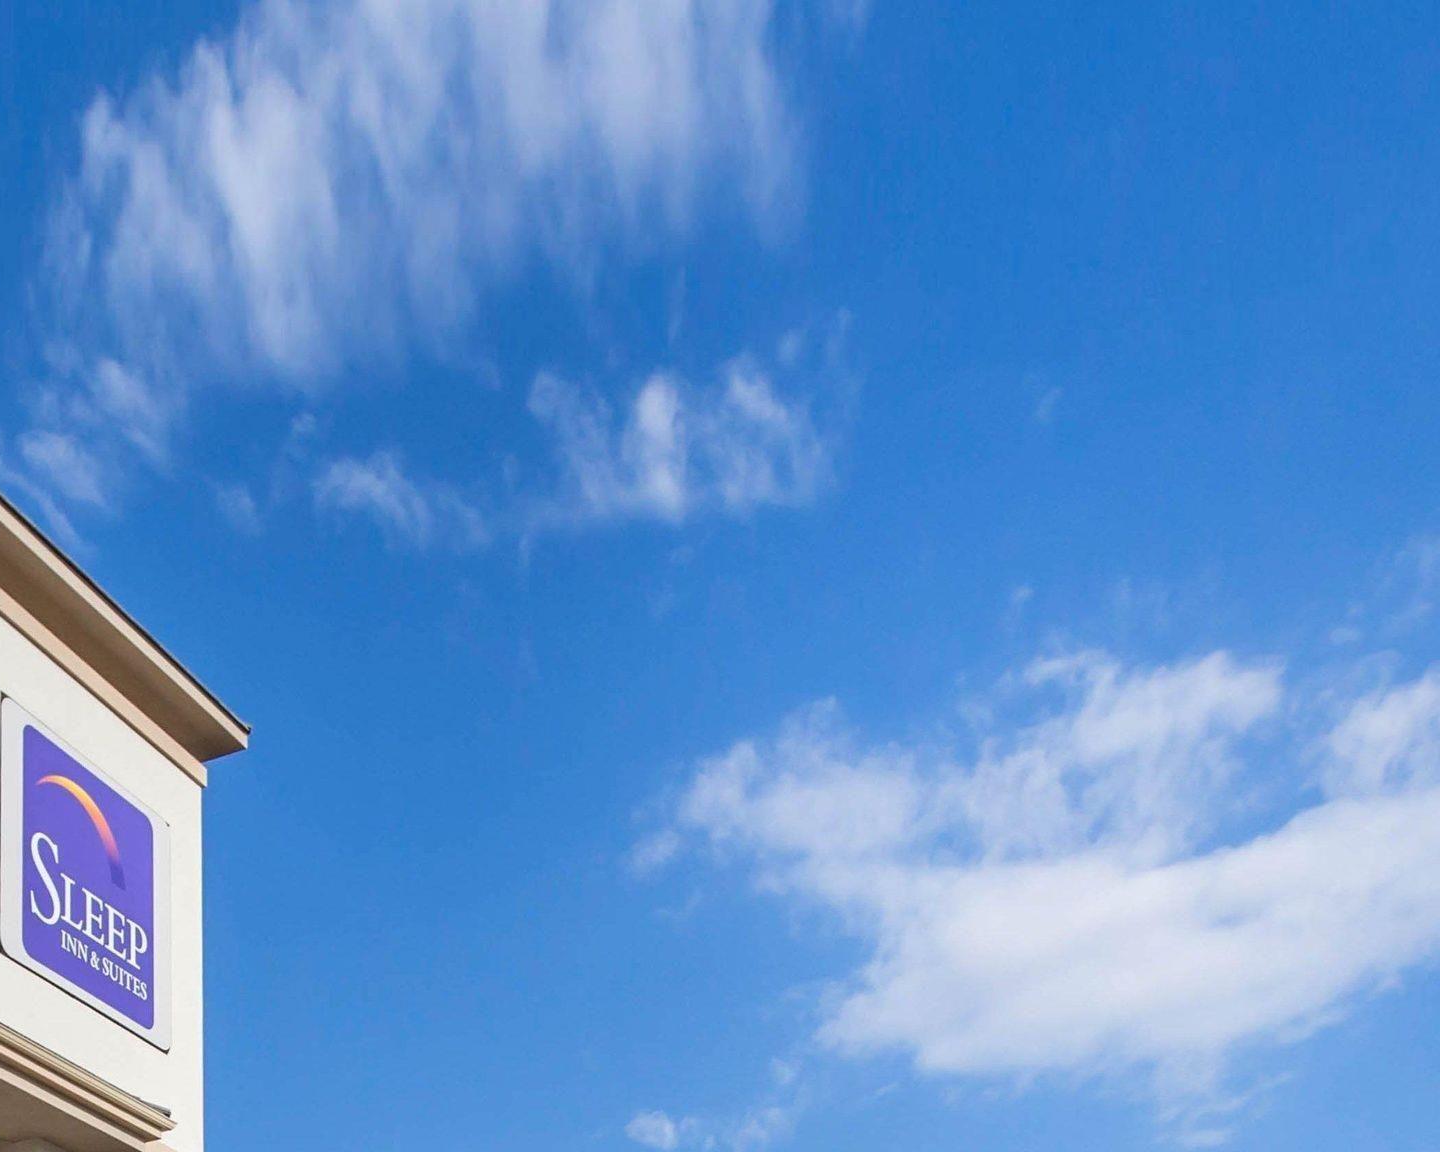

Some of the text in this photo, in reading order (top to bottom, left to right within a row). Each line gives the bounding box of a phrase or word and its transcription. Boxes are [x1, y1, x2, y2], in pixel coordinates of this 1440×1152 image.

[30, 832, 148, 970] SLEEP
[61, 929, 148, 1001] INN & SUITES
